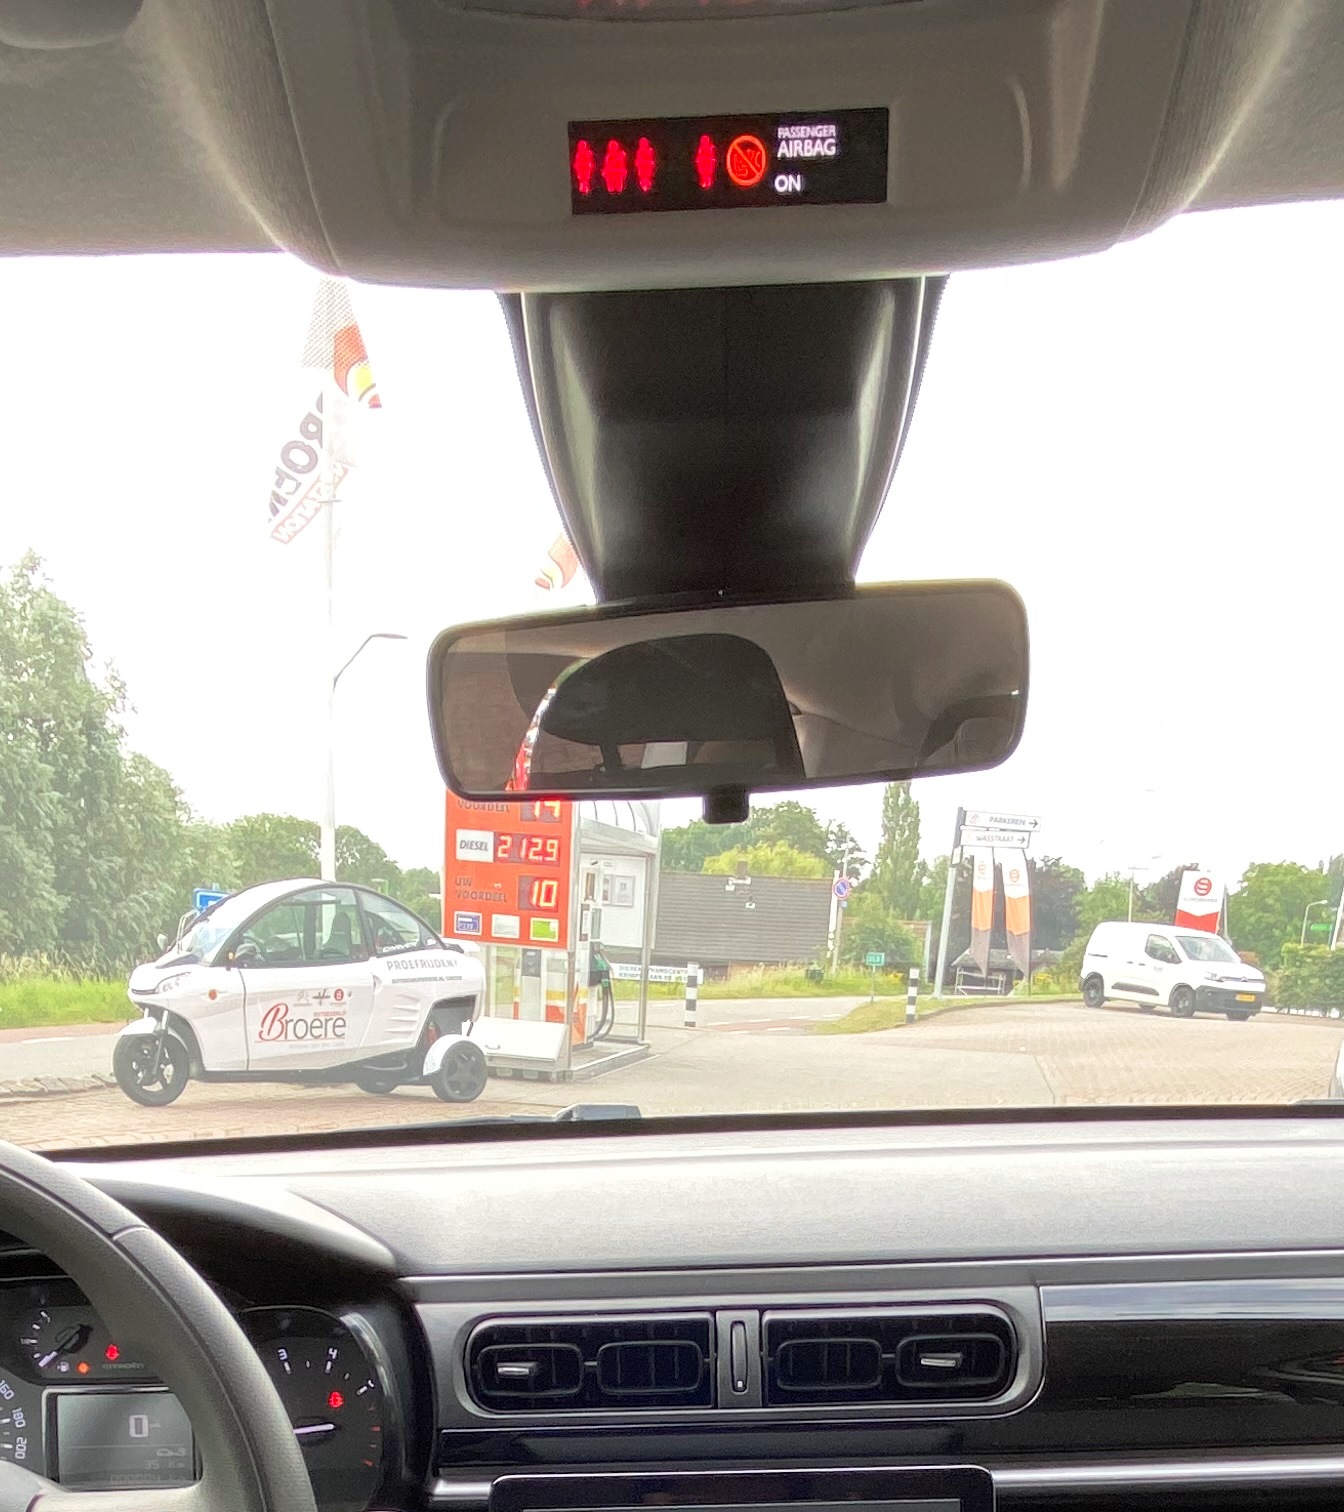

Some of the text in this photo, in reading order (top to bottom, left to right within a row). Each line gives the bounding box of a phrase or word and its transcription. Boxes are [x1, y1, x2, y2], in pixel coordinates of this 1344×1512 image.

[777, 124, 837, 140] PASSENGER
[777, 138, 837, 159] AIRBAG
[774, 174, 802, 193] ON
[459, 839, 489, 852] DIESEL
[532, 880, 558, 907] 10
[258, 1003, 347, 1042] Broere
[278, 1347, 338, 1361] 3 4
[12, 1407, 27, 1429] 180
[14, 1437, 28, 1460] 200
